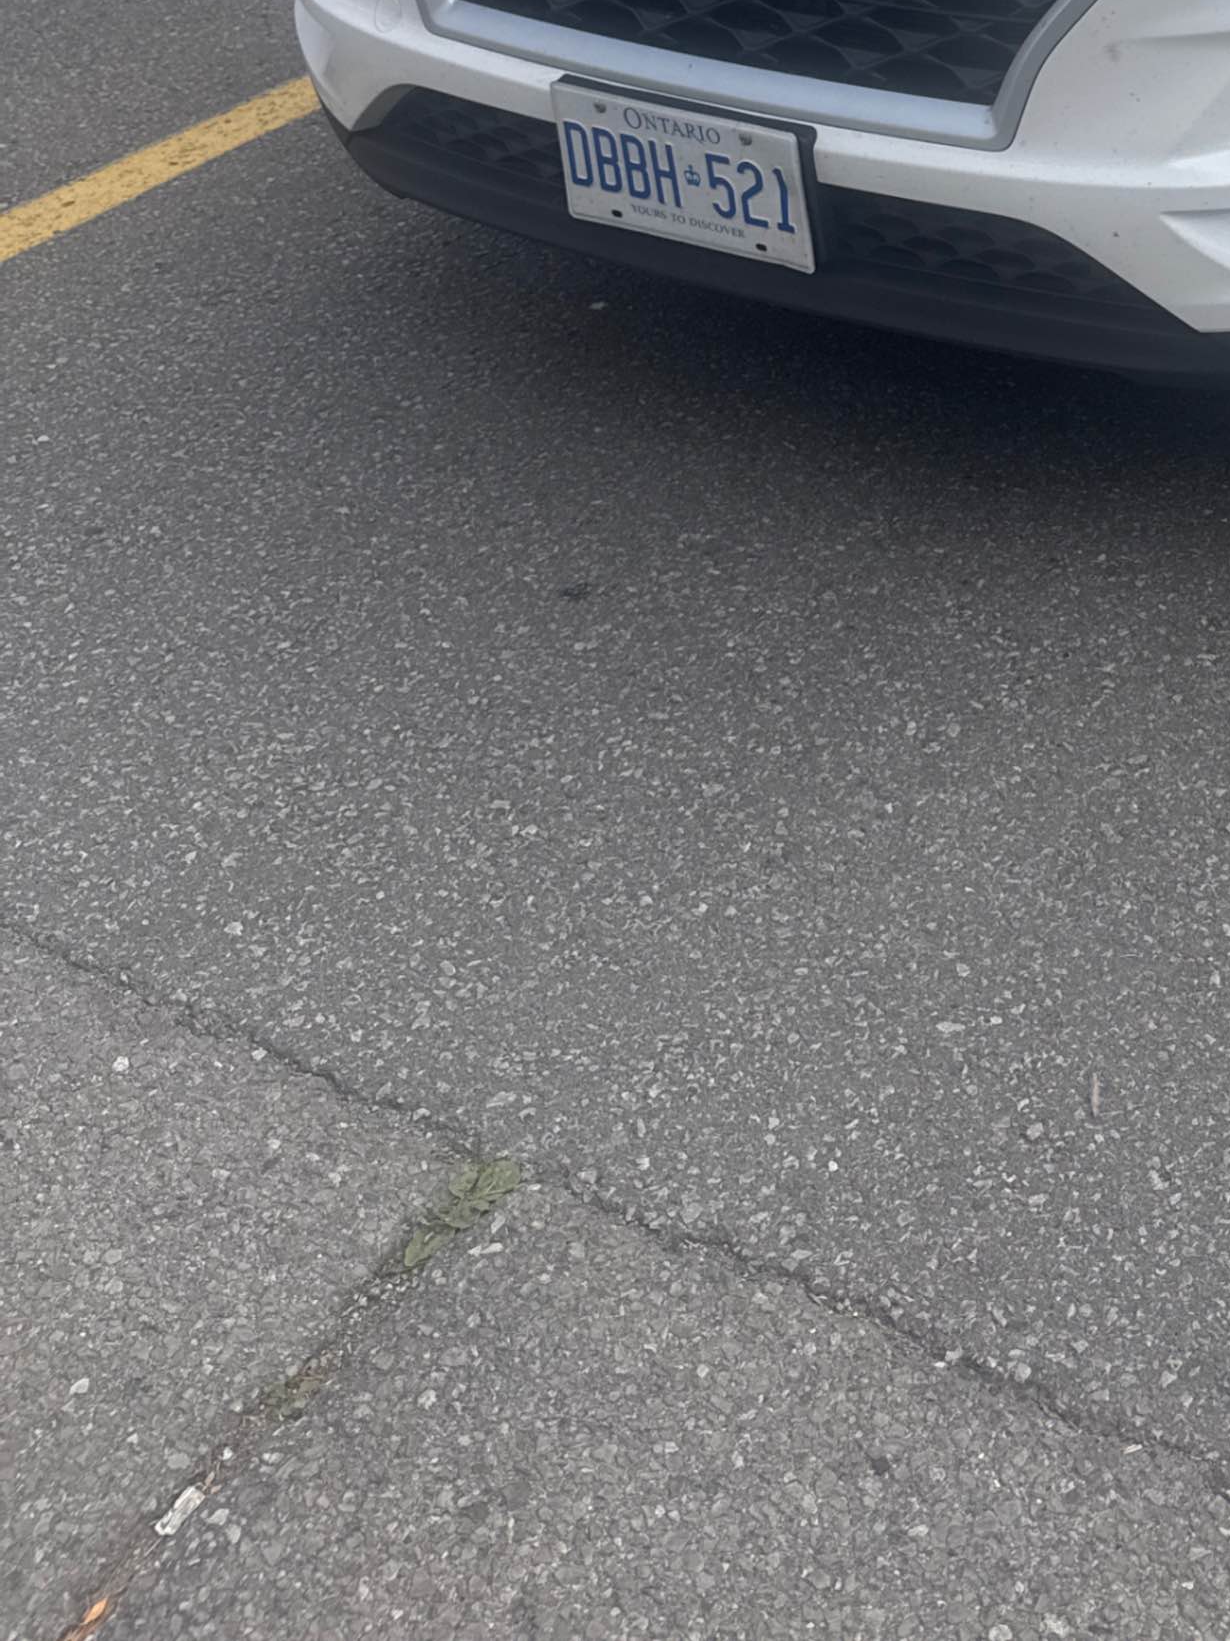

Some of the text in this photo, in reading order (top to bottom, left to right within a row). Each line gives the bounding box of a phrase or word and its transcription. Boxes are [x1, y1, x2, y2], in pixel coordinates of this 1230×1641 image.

[623, 107, 721, 145] ONTARIO
[563, 120, 796, 234] DBBH 521
[630, 203, 747, 239] YOURS TO DISCOVER
